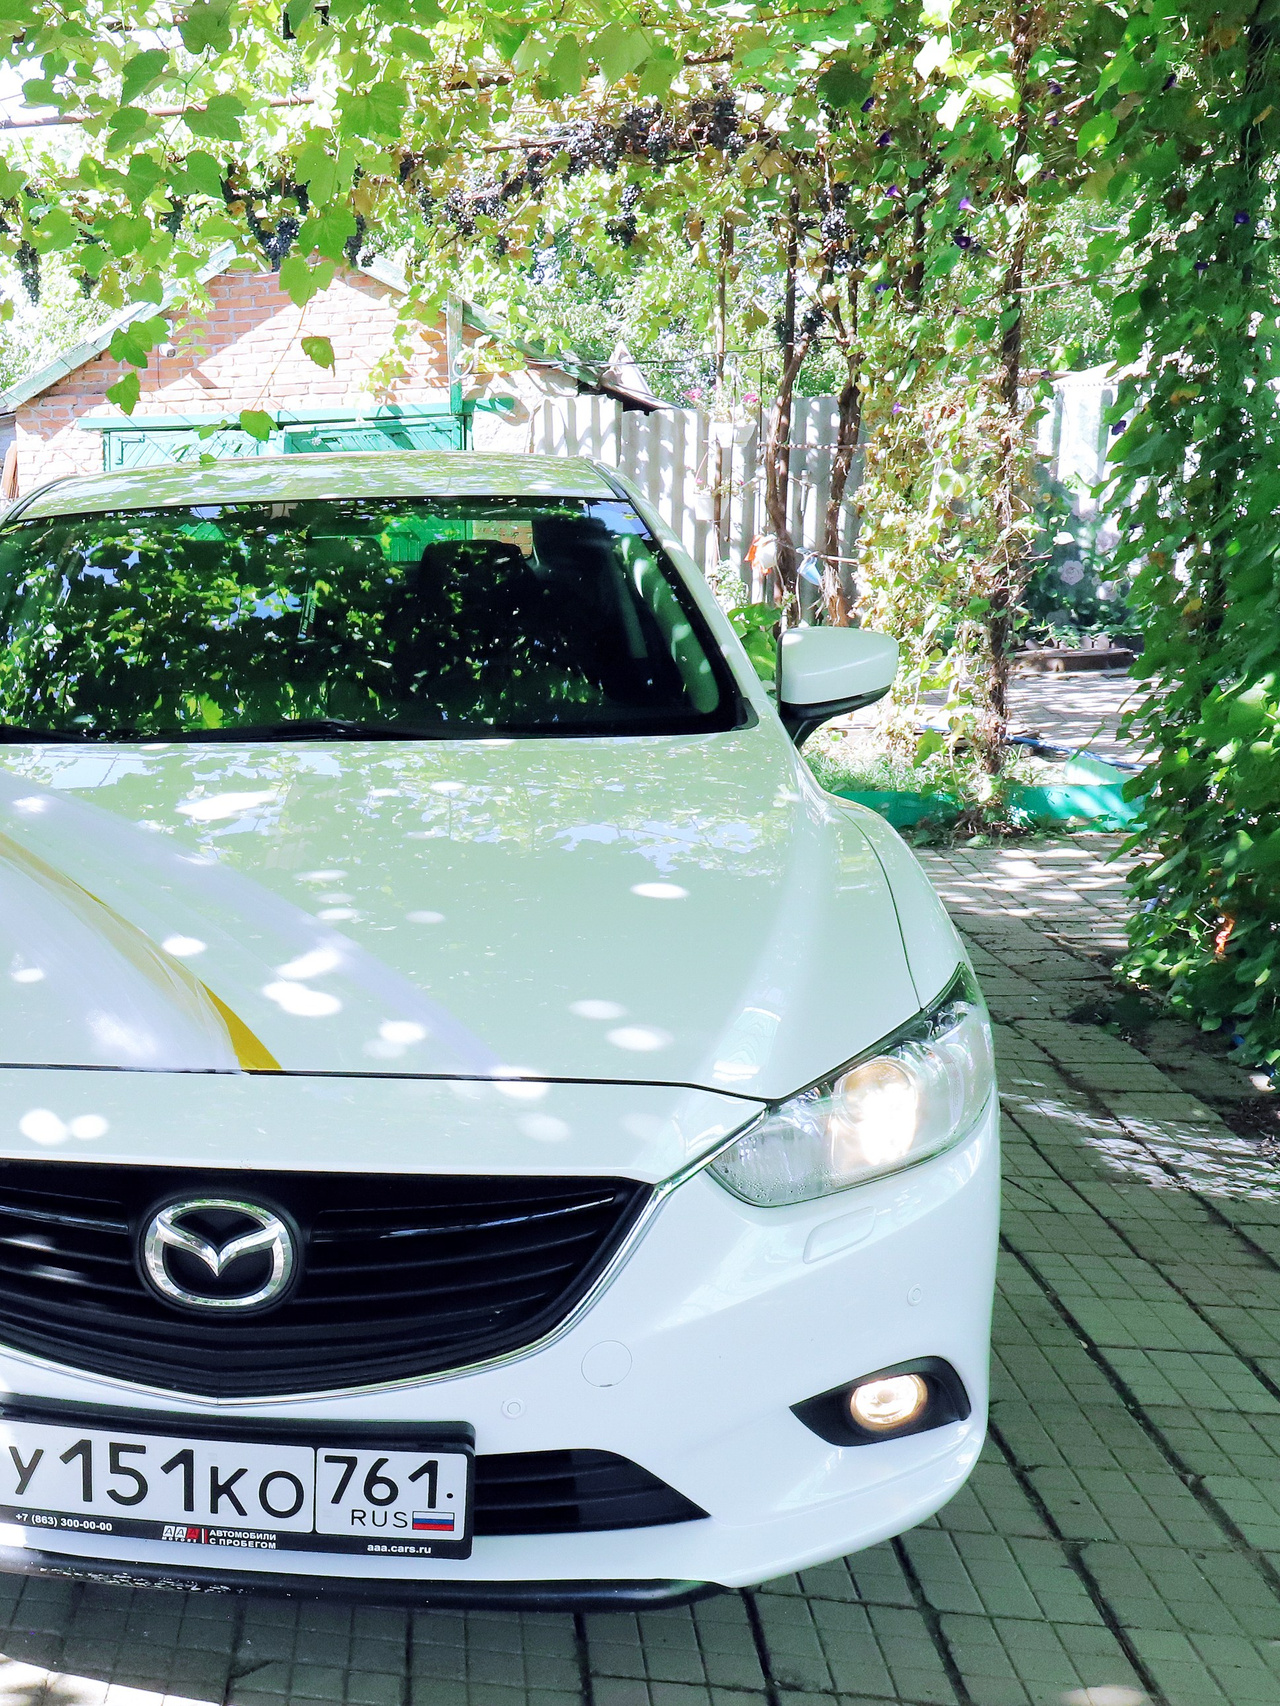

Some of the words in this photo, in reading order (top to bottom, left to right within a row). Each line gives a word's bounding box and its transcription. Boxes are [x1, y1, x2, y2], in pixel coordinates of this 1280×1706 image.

[324, 1455, 439, 1509] 761
[15, 1513, 28, 1522] +7
[31, 1515, 58, 1527] (863)
[60, 1518, 113, 1531] 300-00-00
[351, 1509, 408, 1528] RUS
[209, 1529, 276, 1540] АВТОМОБИЛИ
[209, 1537, 216, 1545] С
[219, 1539, 276, 1549] ПРОБЕГОМ
[367, 1544, 432, 1554] aaa.cars.ru
